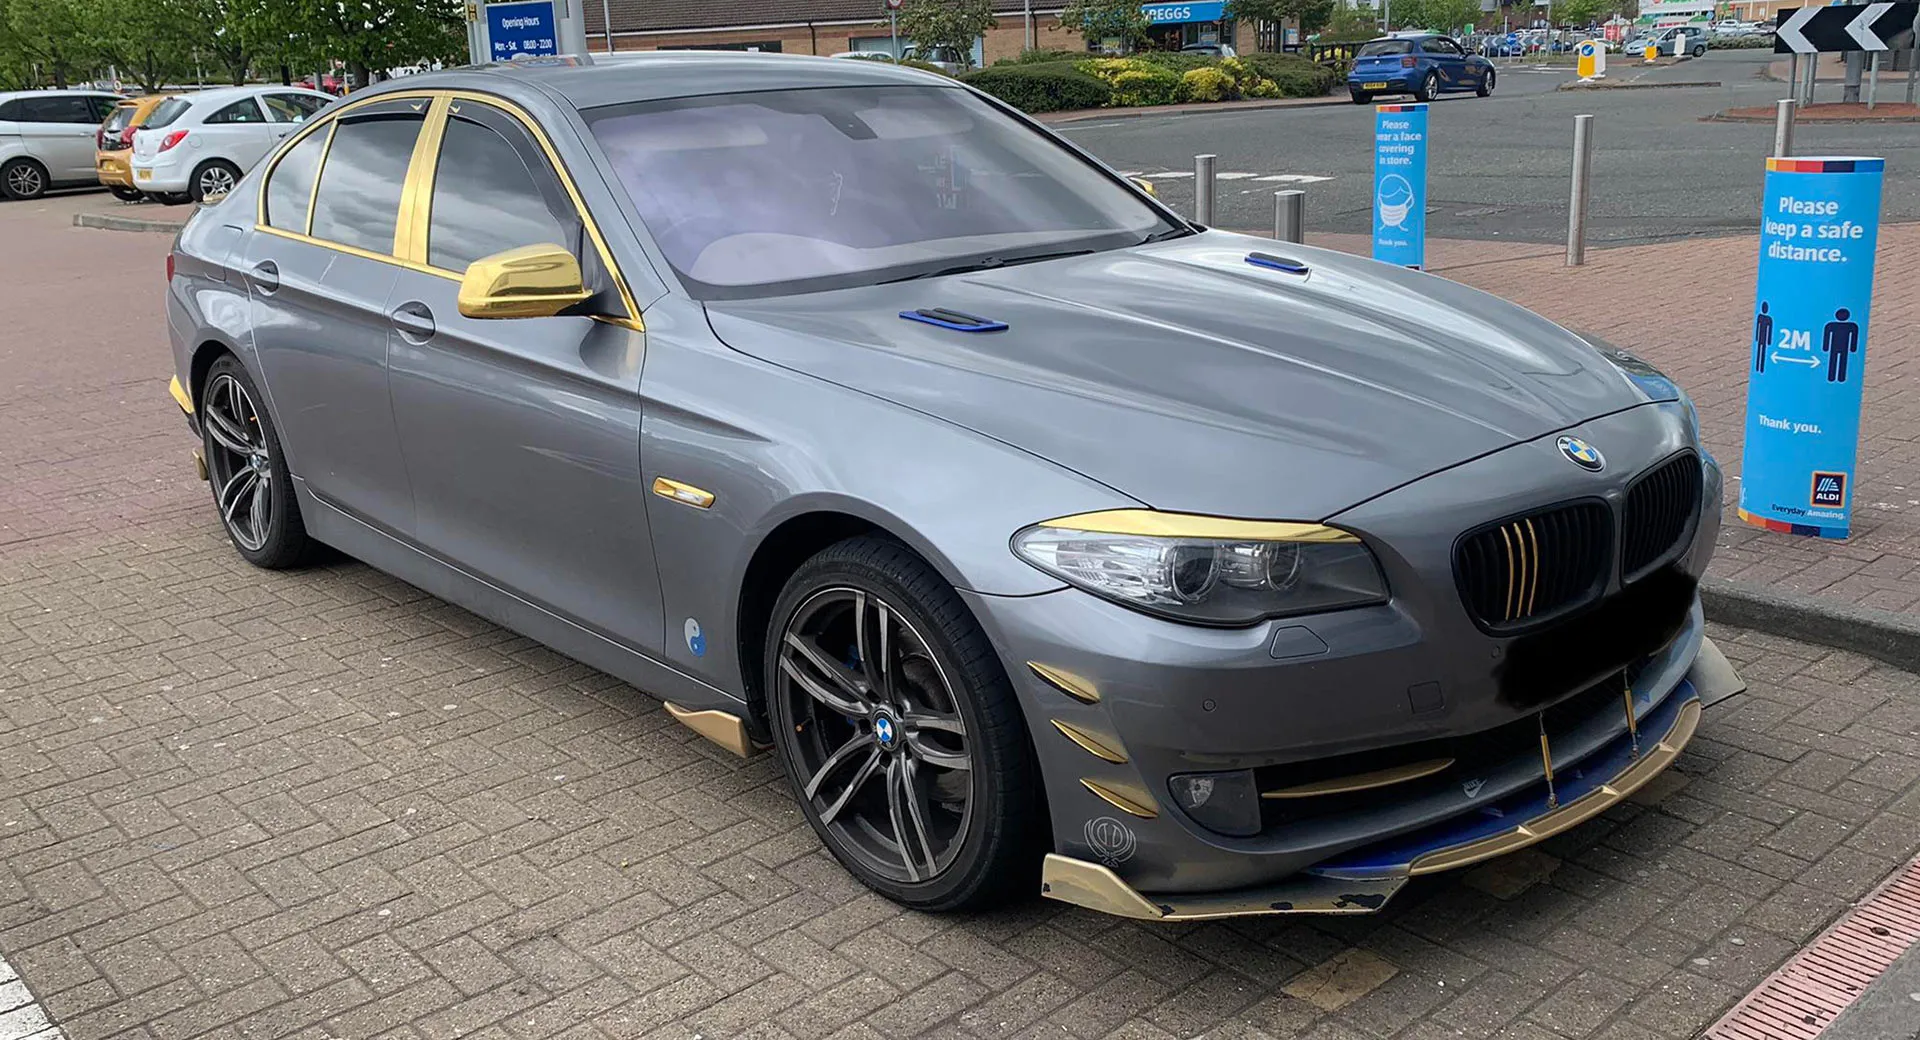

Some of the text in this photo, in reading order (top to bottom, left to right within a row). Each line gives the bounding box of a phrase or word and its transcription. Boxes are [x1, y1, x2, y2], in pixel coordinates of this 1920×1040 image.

[1142, 7, 1191, 20] REGGS
[502, 17, 540, 30] Opening Hours
[1382, 120, 1410, 129] Please
[1392, 133, 1399, 141] a
[1400, 131, 1422, 141] face
[1379, 144, 1414, 155] covering
[1379, 155, 1412, 165] in store.
[1779, 196, 1839, 215] Please
[1765, 216, 1864, 241] keep a safe
[1768, 241, 1848, 262] distance.
[1778, 328, 1811, 351] 2M
[1759, 414, 1822, 434] Thank you.
[1816, 493, 1840, 501] ALDI
[1772, 503, 1806, 517] Everyday
